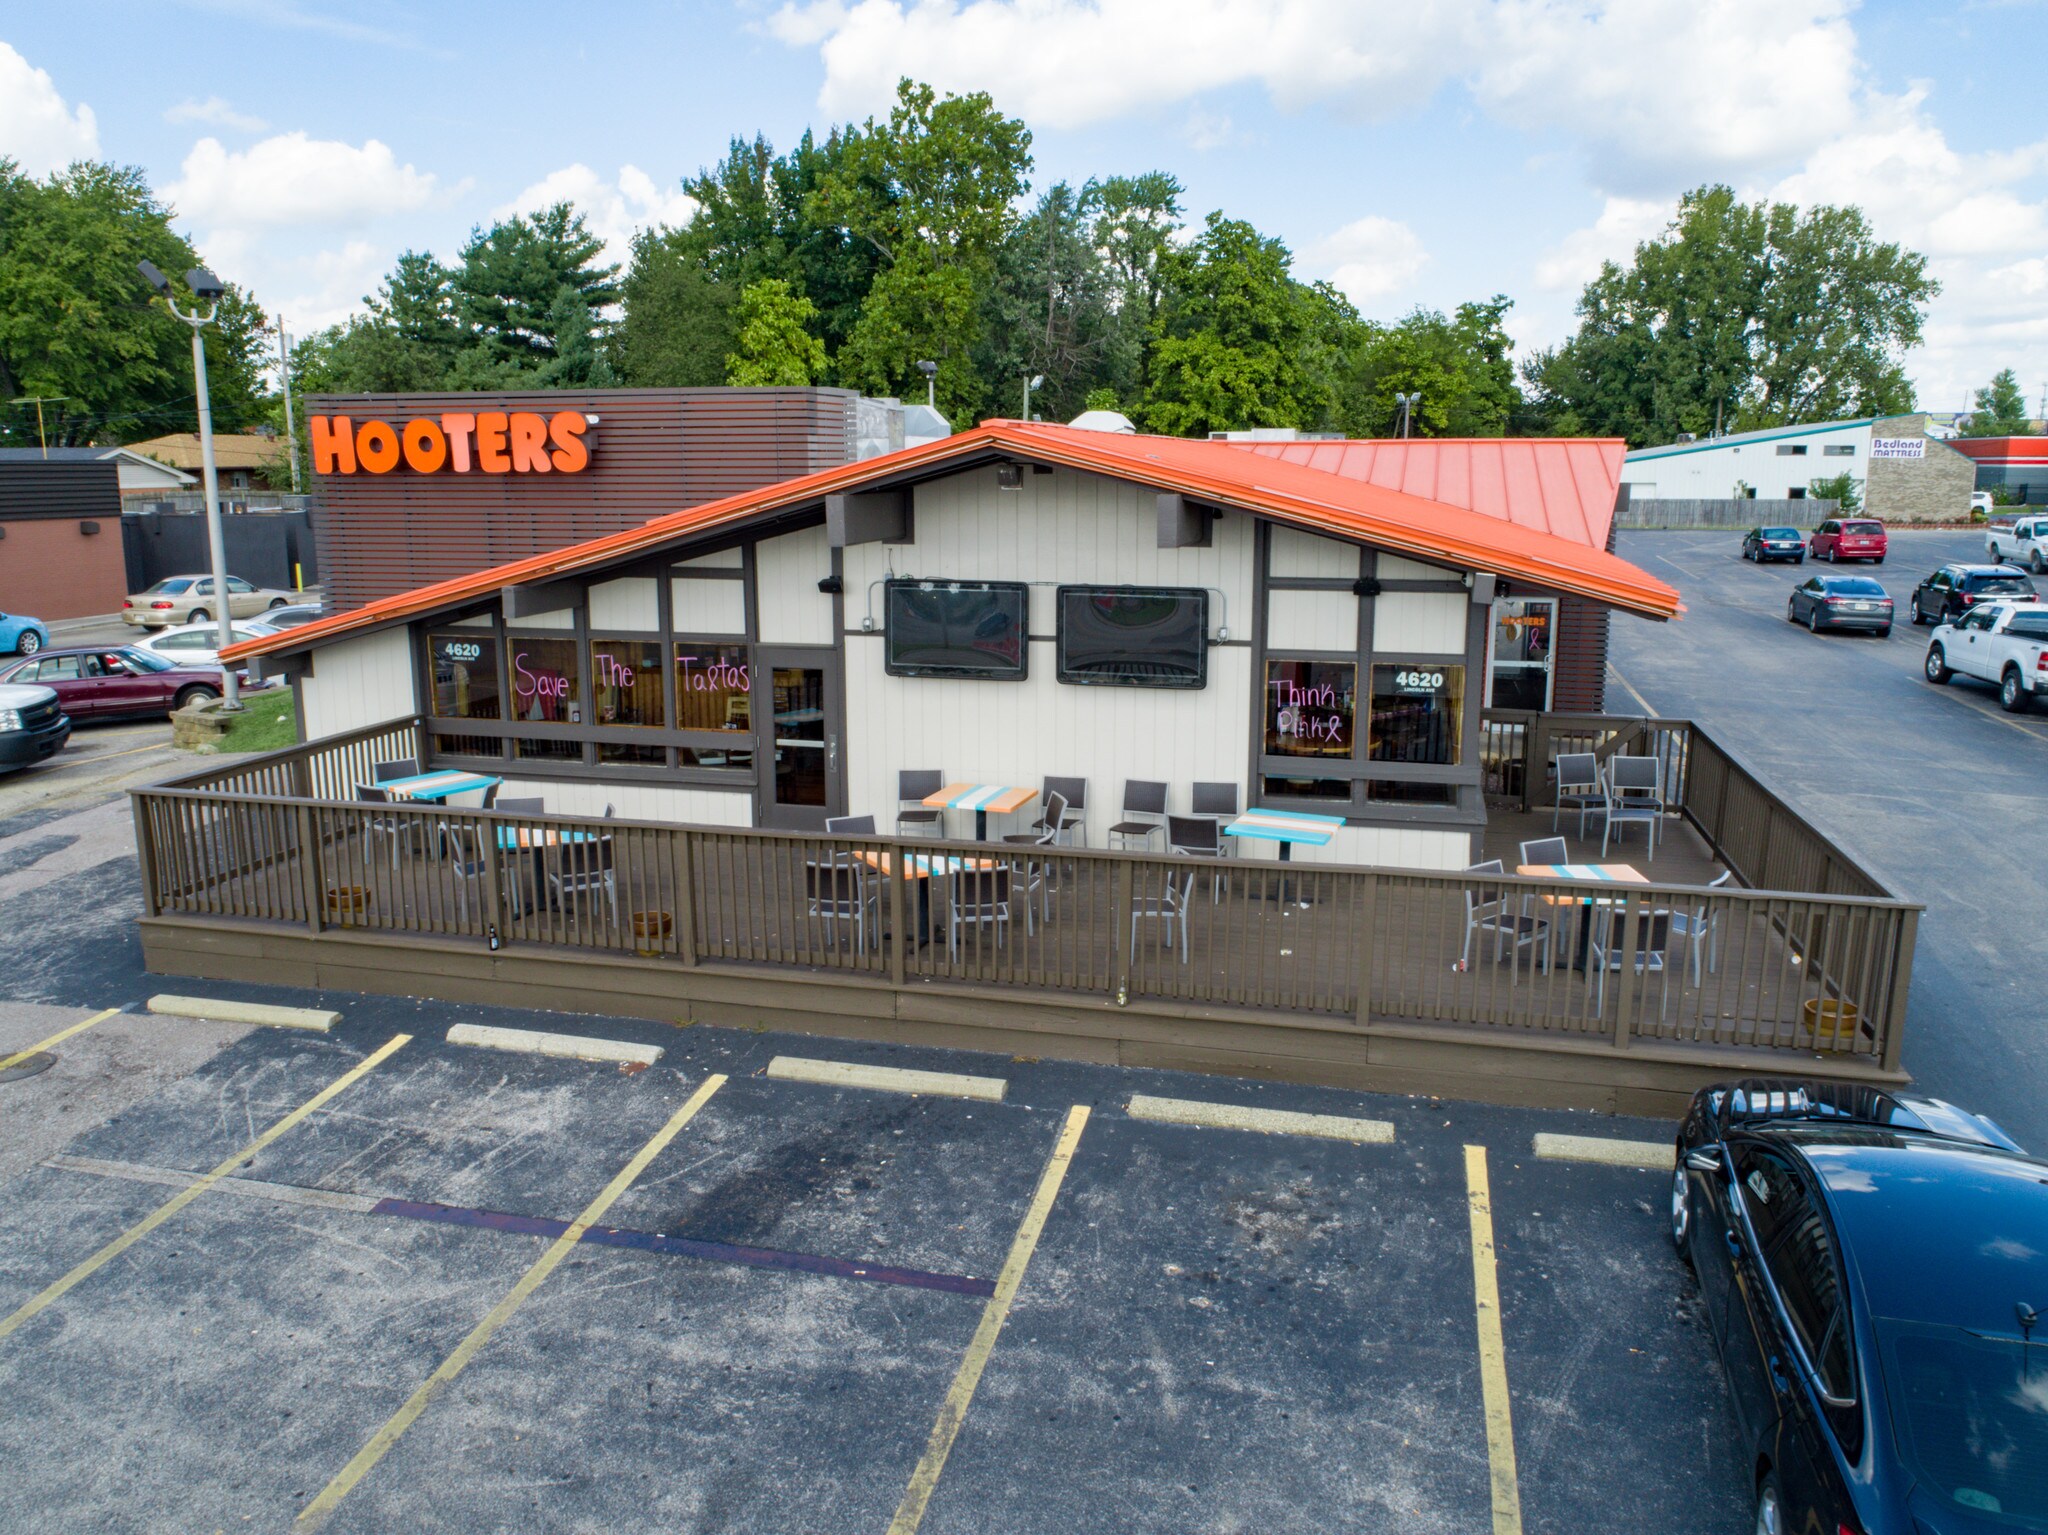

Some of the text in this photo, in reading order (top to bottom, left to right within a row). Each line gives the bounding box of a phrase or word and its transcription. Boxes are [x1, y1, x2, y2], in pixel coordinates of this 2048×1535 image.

[310, 410, 590, 475] HOOTERS
[1873, 439, 1924, 449] Bedland
[1873, 449, 1922, 457] MATTRESS
[445, 642, 480, 657] 4620
[515, 653, 569, 697] Save
[595, 654, 635, 687] The
[1395, 671, 1444, 688] 4620
